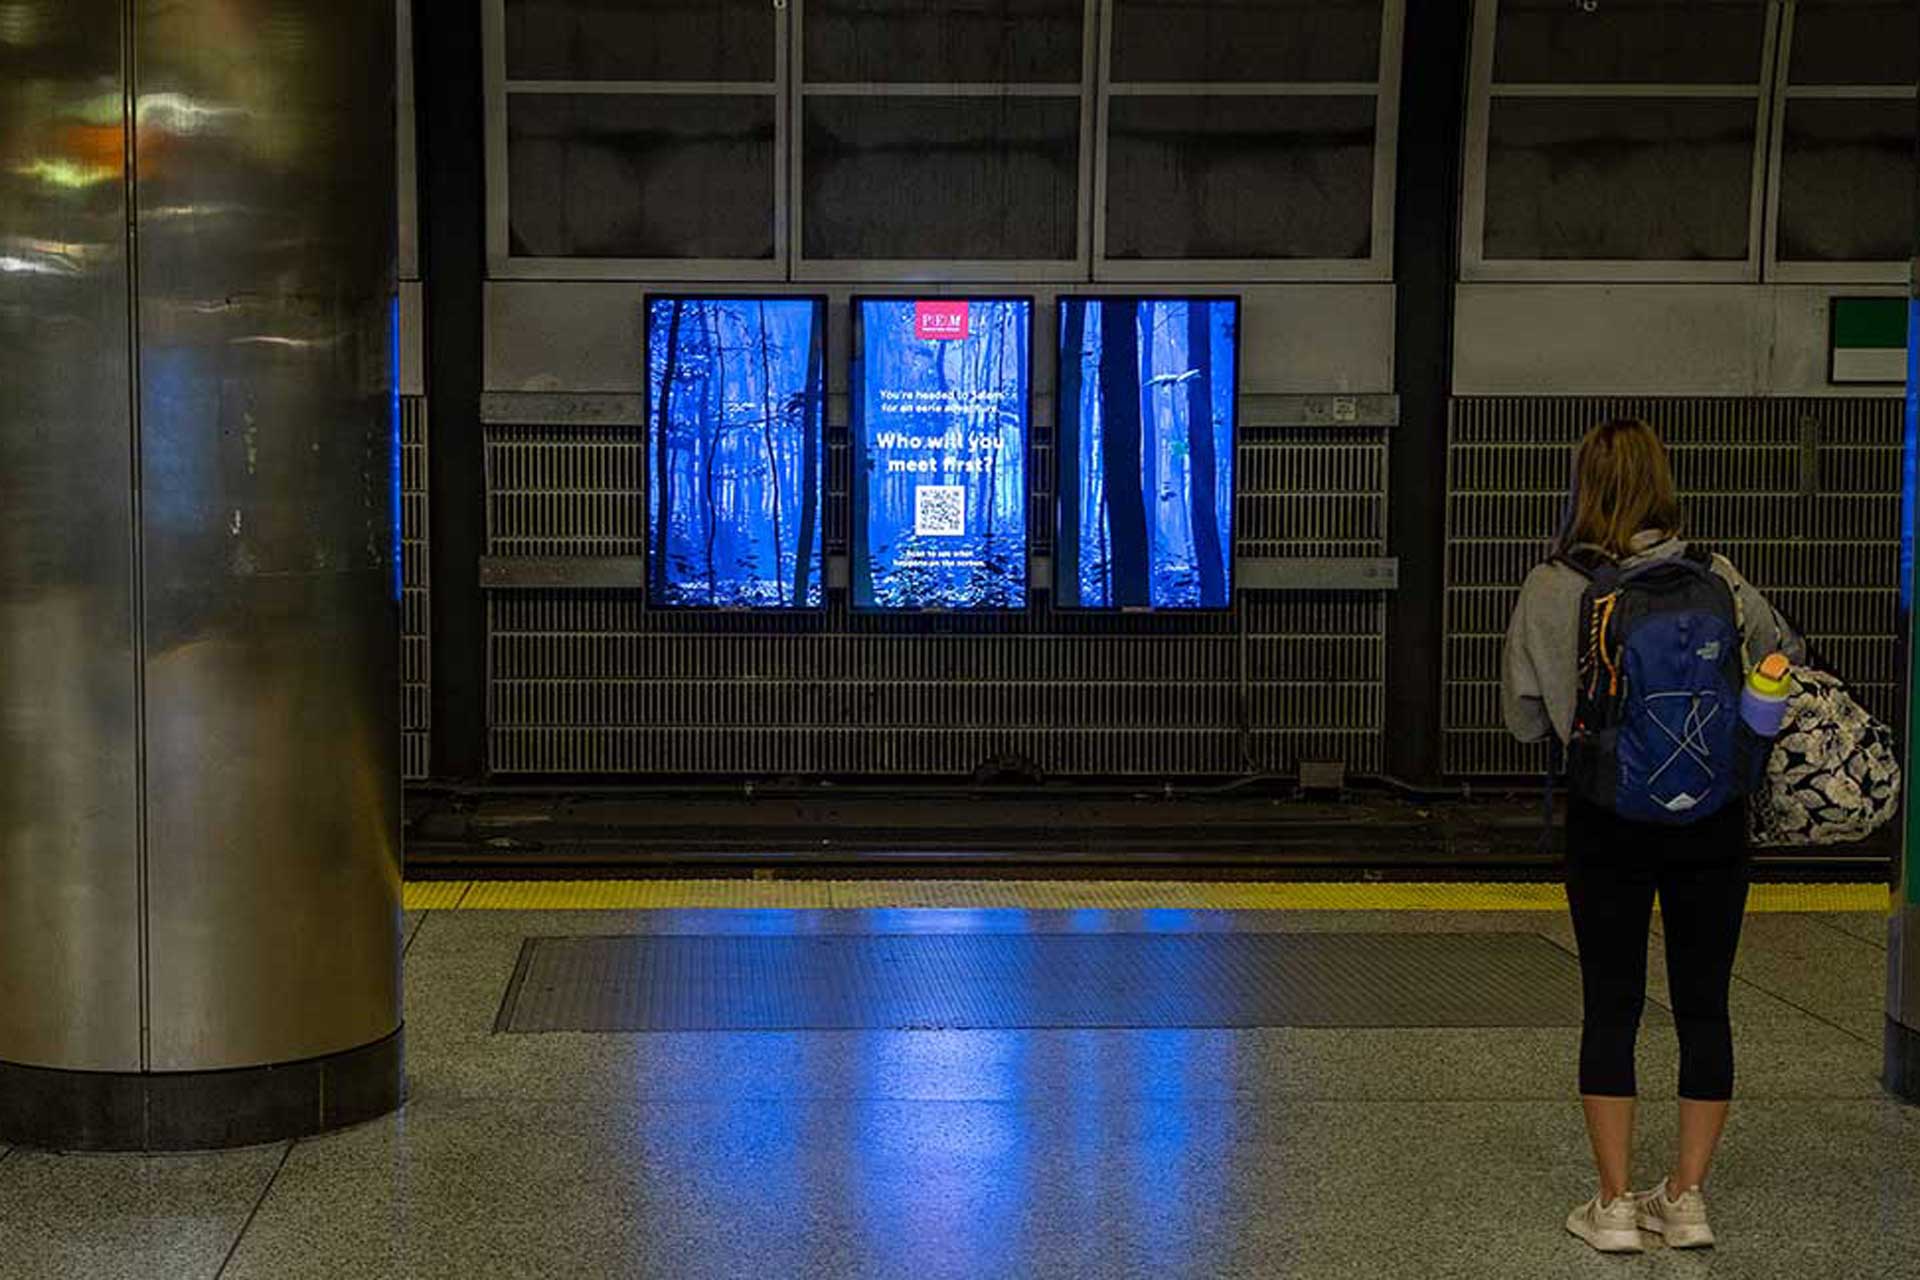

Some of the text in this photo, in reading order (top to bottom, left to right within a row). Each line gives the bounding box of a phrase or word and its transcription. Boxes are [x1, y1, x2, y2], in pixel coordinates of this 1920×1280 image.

[916, 390, 954, 400] headed
[881, 403, 897, 412] for
[877, 432, 1004, 453] Who will you
[888, 456, 993, 472] meet first?
